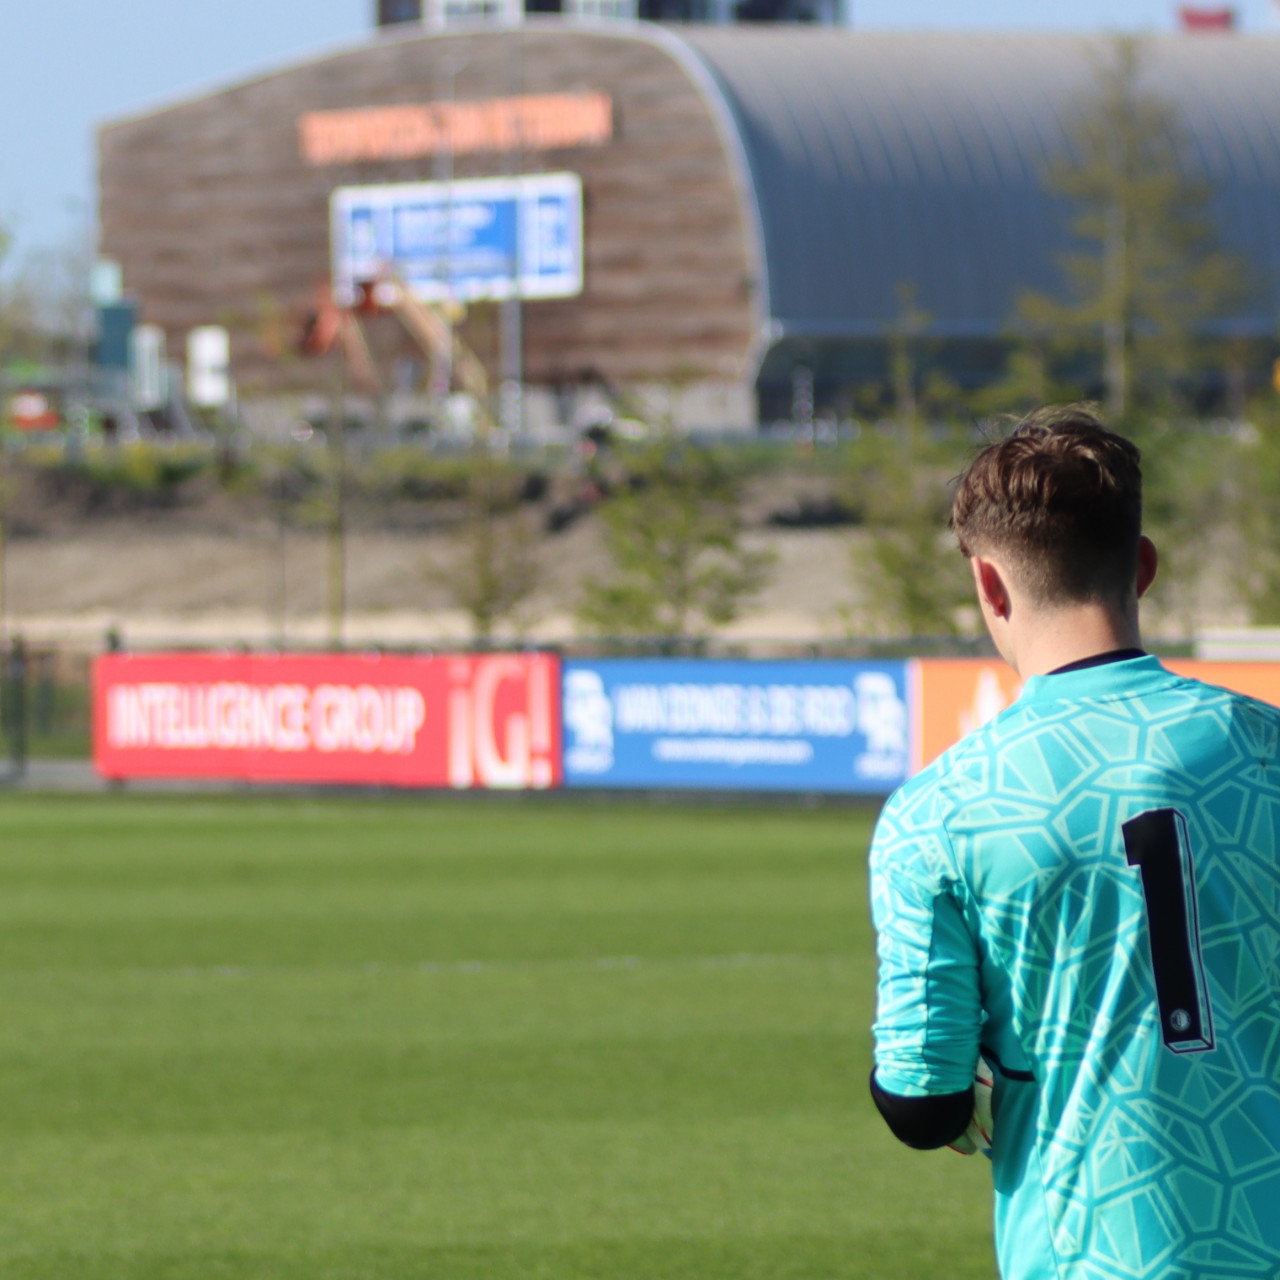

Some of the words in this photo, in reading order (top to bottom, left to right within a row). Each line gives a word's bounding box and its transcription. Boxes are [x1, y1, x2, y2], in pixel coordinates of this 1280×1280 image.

[108, 682, 310, 750] INTELLIGENCE
[312, 685, 425, 754] GROUP
[1122, 808, 1216, 1055] 1
